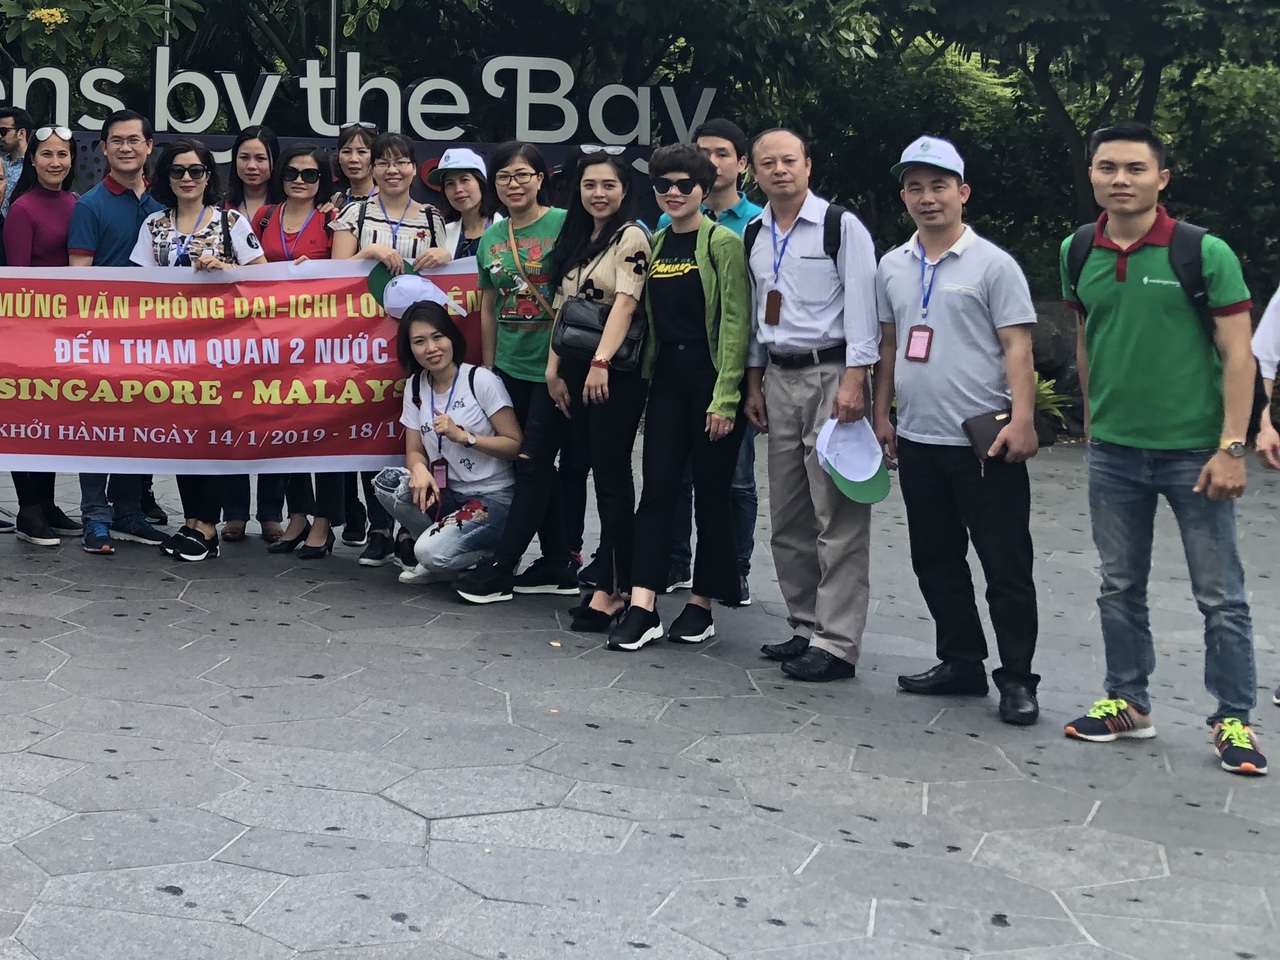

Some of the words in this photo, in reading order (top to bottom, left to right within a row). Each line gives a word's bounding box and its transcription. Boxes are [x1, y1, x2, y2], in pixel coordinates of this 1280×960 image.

[154, 46, 282, 163] by
[299, 51, 470, 141] the
[481, 55, 717, 174] Bay
[77, 291, 130, 319] VĂN
[139, 291, 225, 320] PHÒNG
[54, 330, 110, 364] ĐẾN
[120, 338, 197, 364] THAM
[206, 337, 280, 368] QUAN
[289, 337, 305, 364] 2
[314, 331, 388, 364] NƯỚC
[57, 421, 125, 442] HÀNH
[132, 423, 199, 445] NGÀY
[207, 428, 326, 448] 14/1/2019
